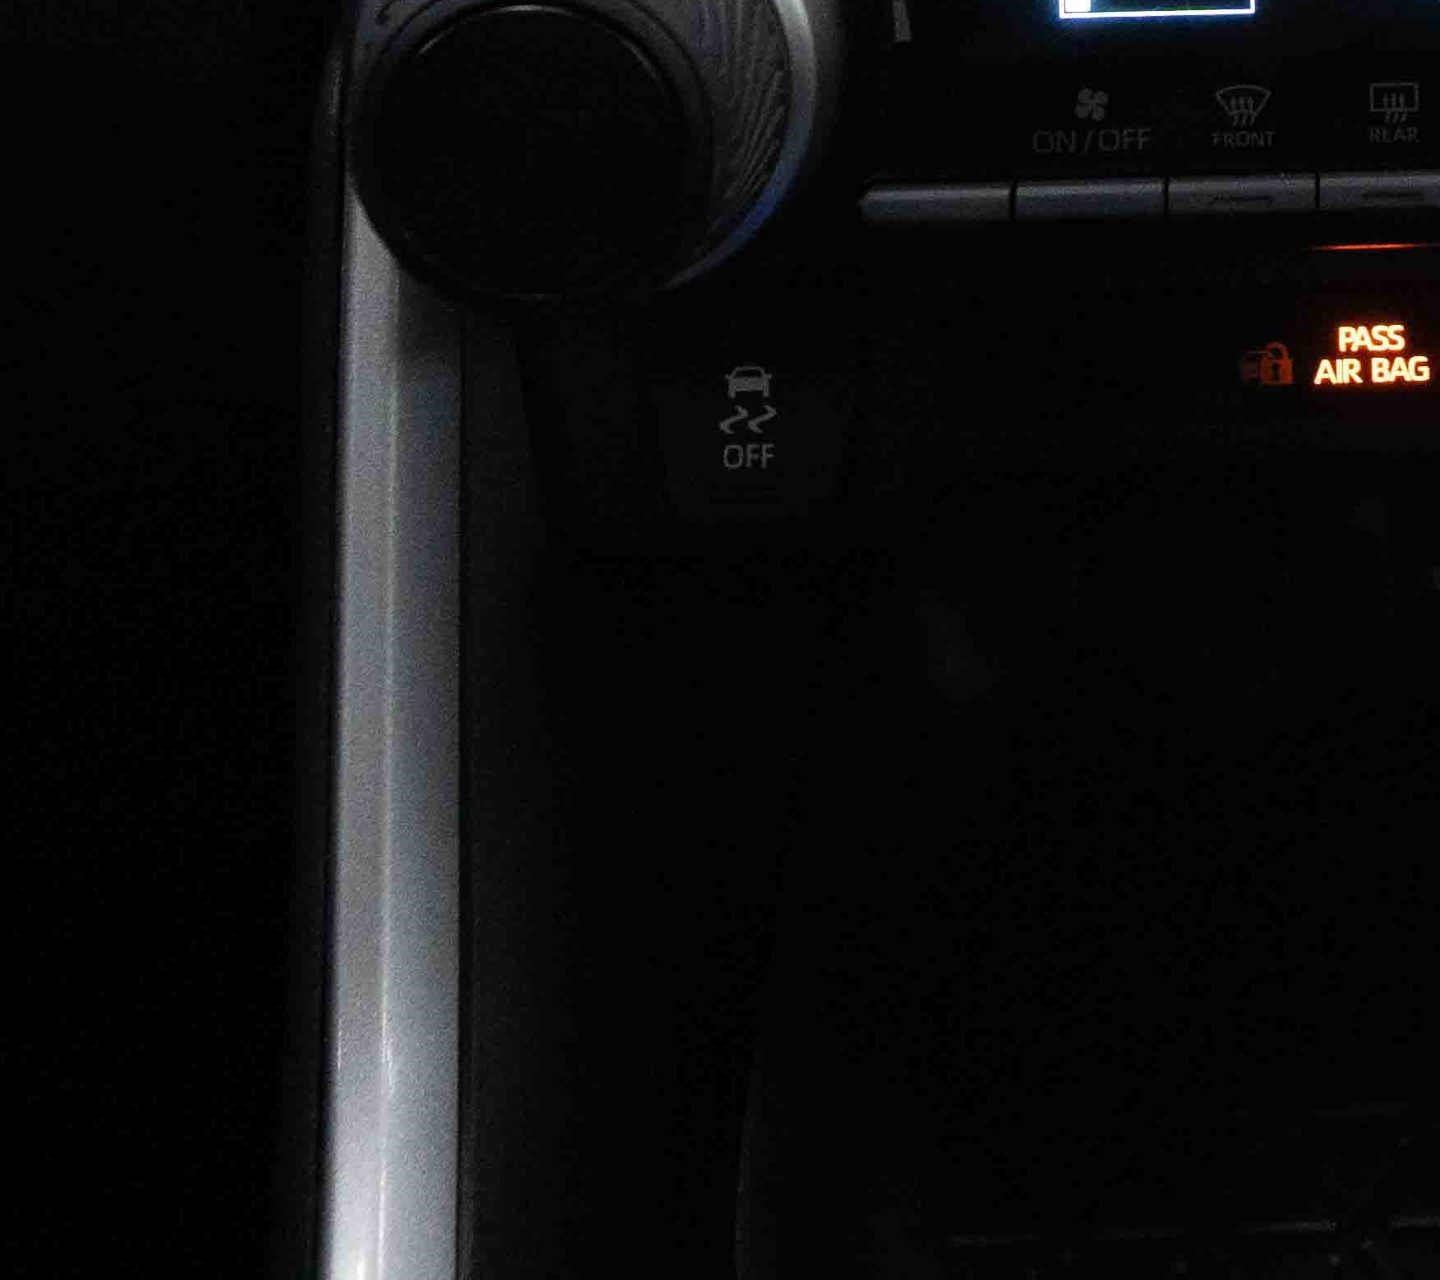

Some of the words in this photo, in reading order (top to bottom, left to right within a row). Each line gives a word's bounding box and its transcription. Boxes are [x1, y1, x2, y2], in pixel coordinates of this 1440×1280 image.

[1031, 126, 1153, 154] ON/OFF
[1210, 129, 1277, 149] FRONT
[1367, 125, 1420, 144] REAR
[1337, 323, 1407, 354] PASS
[1313, 357, 1364, 386] AIR
[1370, 354, 1431, 383] BAG
[722, 443, 777, 470] OFF
